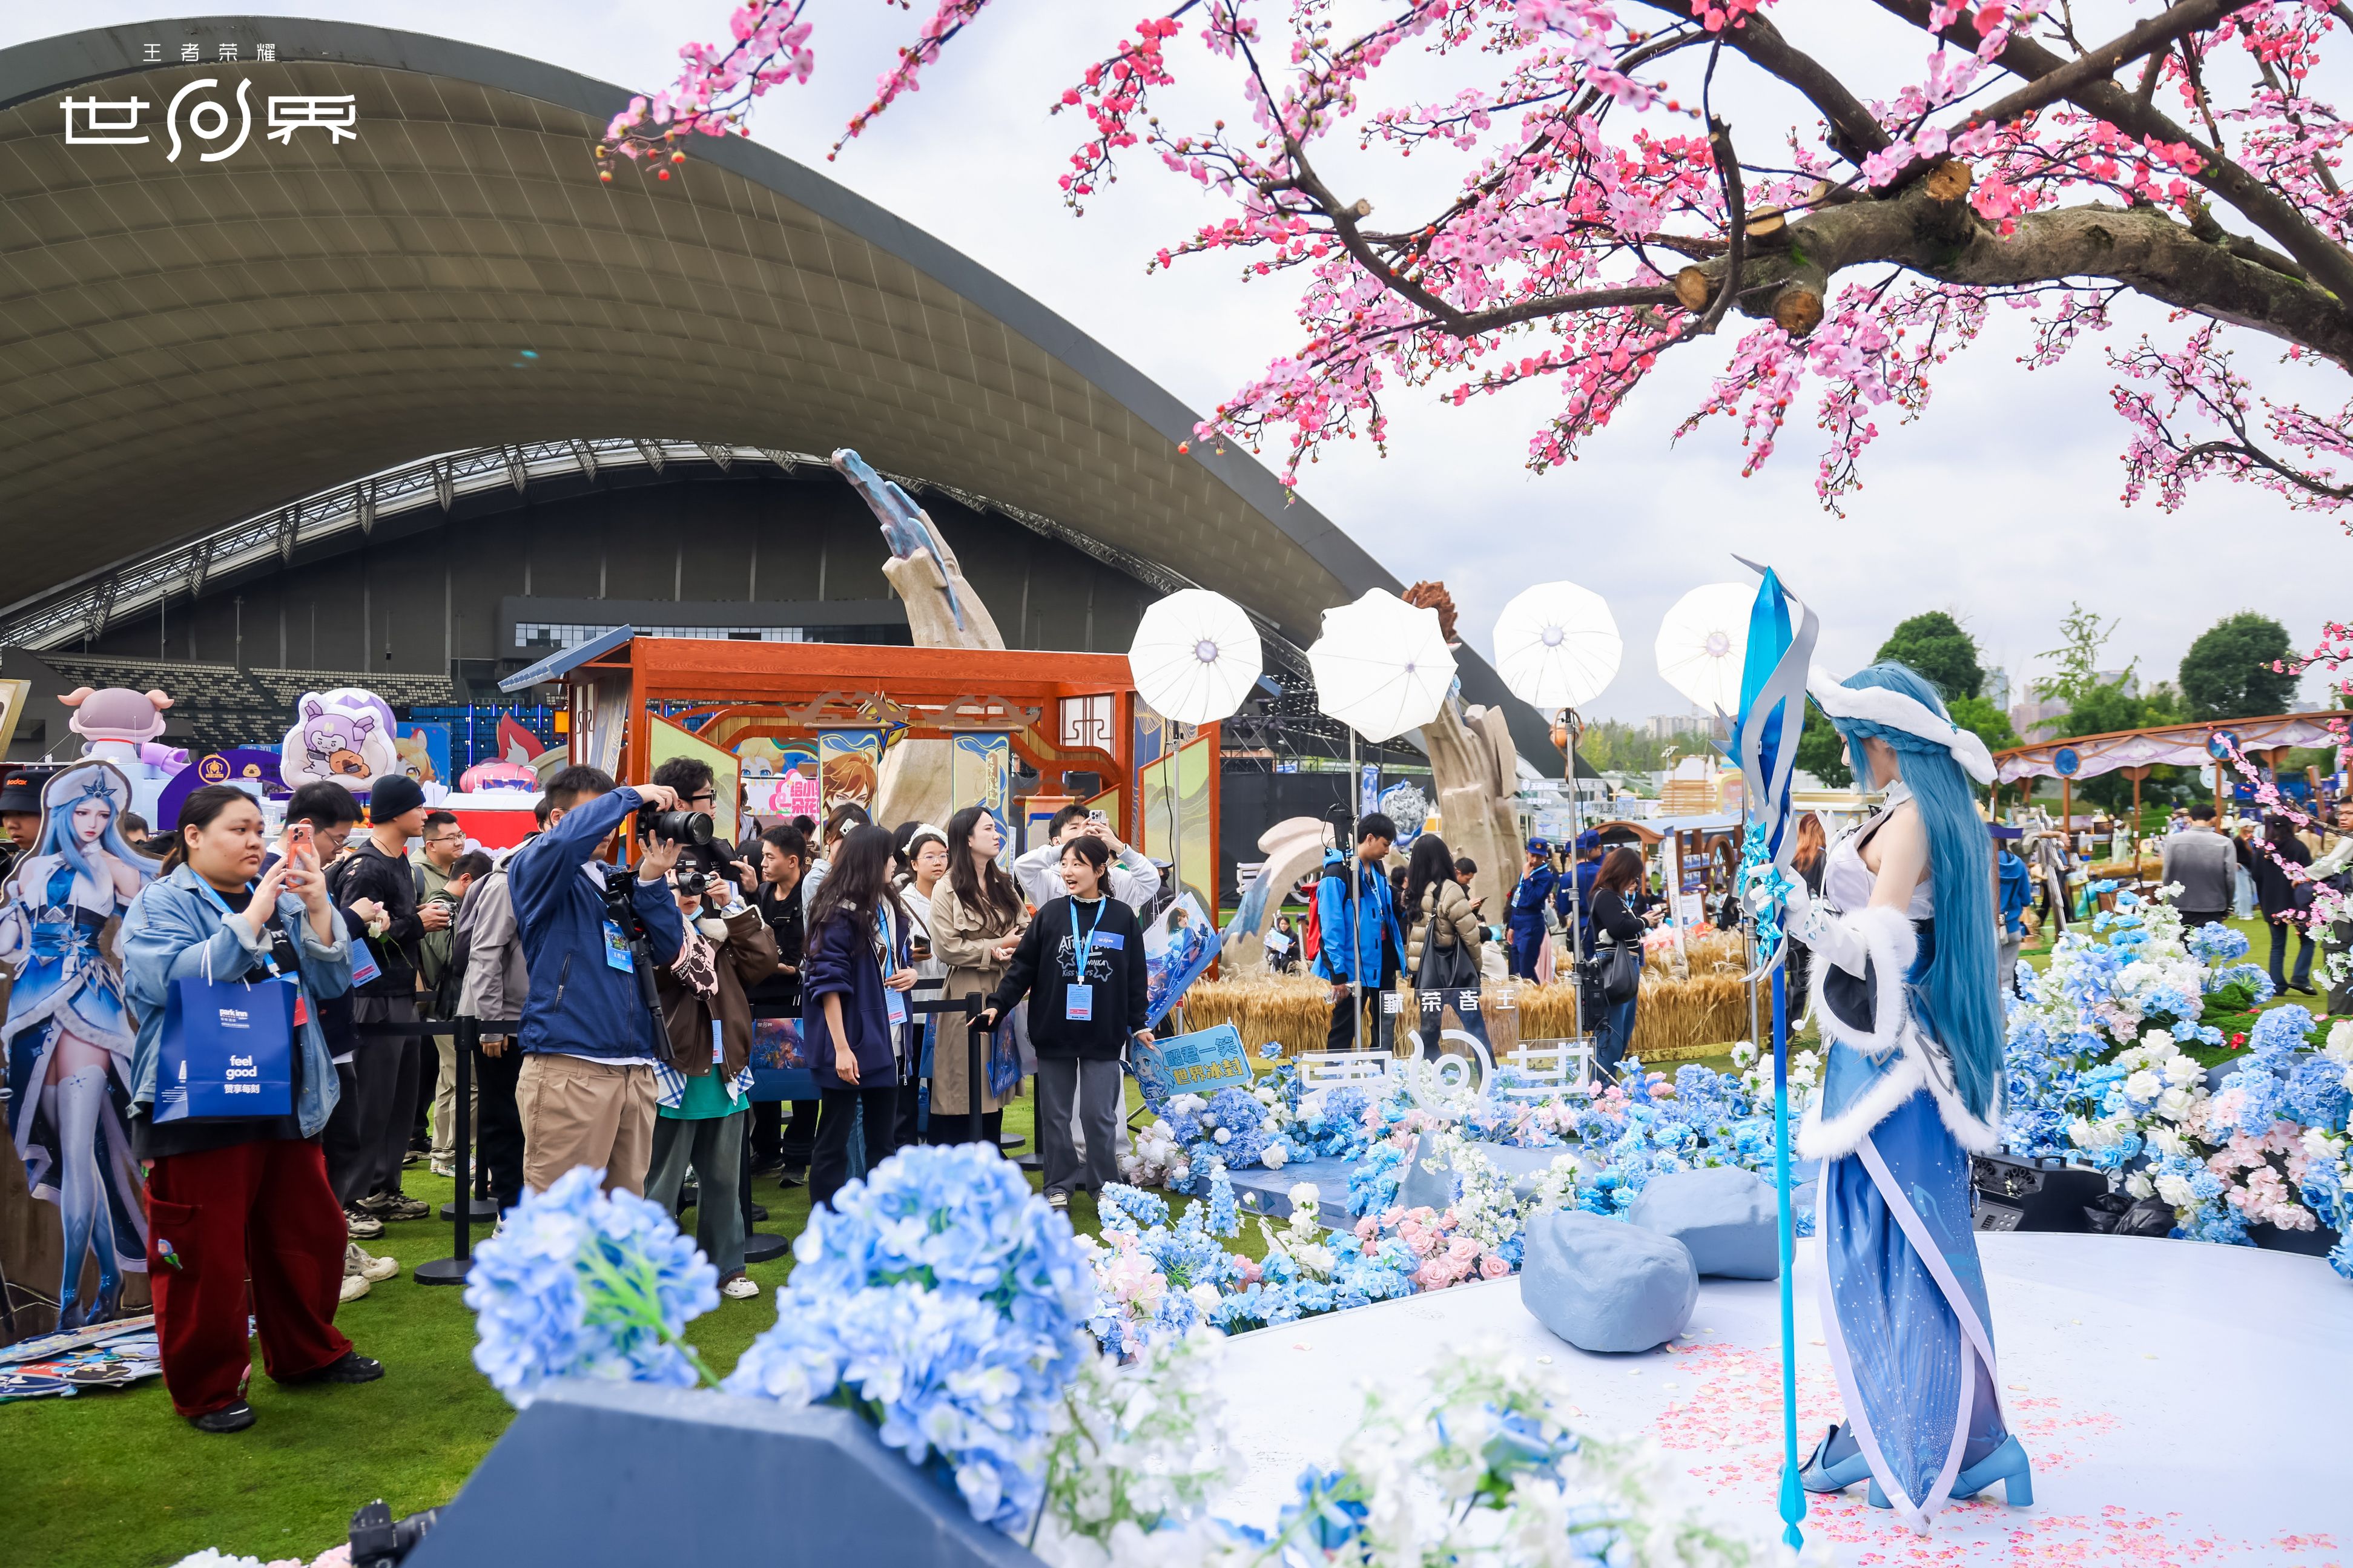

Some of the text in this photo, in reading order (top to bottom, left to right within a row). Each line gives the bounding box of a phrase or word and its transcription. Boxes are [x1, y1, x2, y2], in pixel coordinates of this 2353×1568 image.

[790, 781, 819, 797] 给小
[779, 797, 819, 814] 一朵花
[1164, 1036, 1238, 1067] 昭君一笑
[229, 1055, 252, 1066] feel
[226, 1066, 257, 1080] good
[1172, 1056, 1244, 1085] 世界冰封
[224, 1084, 260, 1093] 赞享每刻
